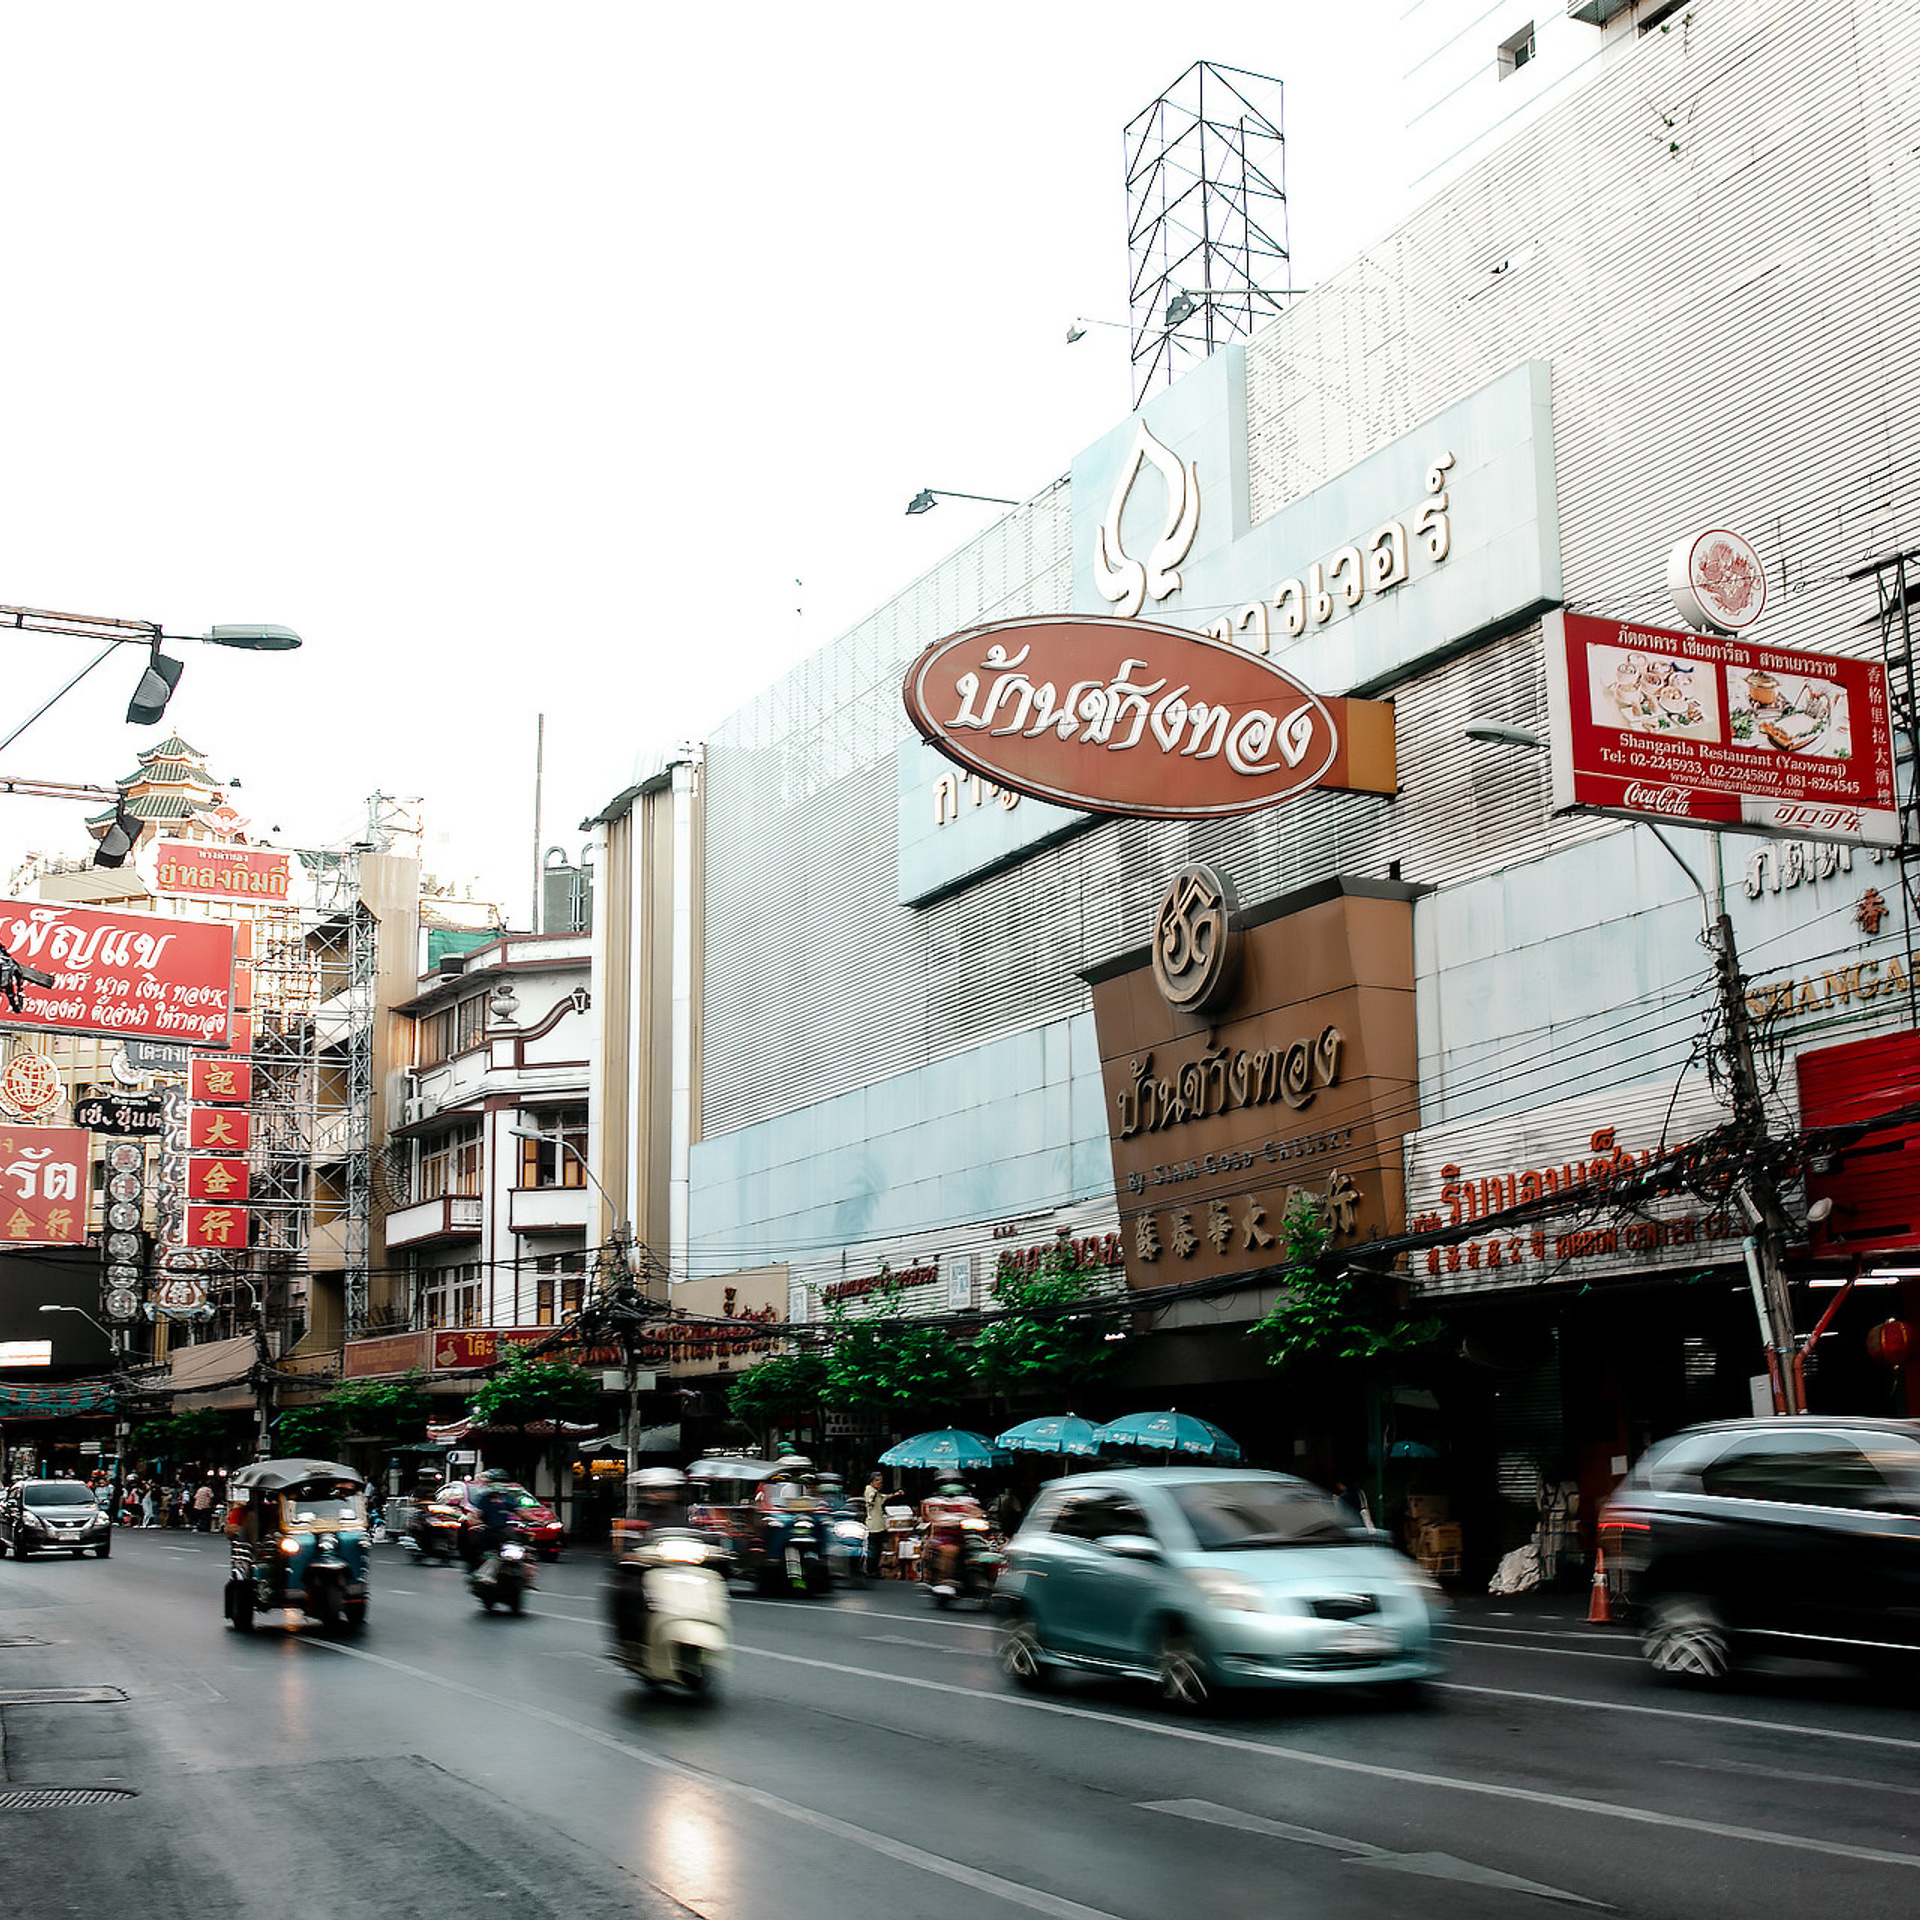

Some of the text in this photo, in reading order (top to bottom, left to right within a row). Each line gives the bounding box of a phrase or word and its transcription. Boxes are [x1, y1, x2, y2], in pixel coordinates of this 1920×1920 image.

[1617, 625, 1677, 652] ภัตตาคาร
[1759, 652, 1838, 677] สาขาเยาวราช
[944, 643, 1315, 776] บ้านช่างทอง
[1600, 747, 1627, 764] Tel:
[1620, 732, 1847, 778] Shangarila Restaurant (Yaowaraj)
[49, 970, 93, 992] พชร
[1117, 1023, 1343, 1141] บ้านช่างทอง
[1127, 1171, 1145, 1195] By
[1555, 1226, 1618, 1260] RIBBON
